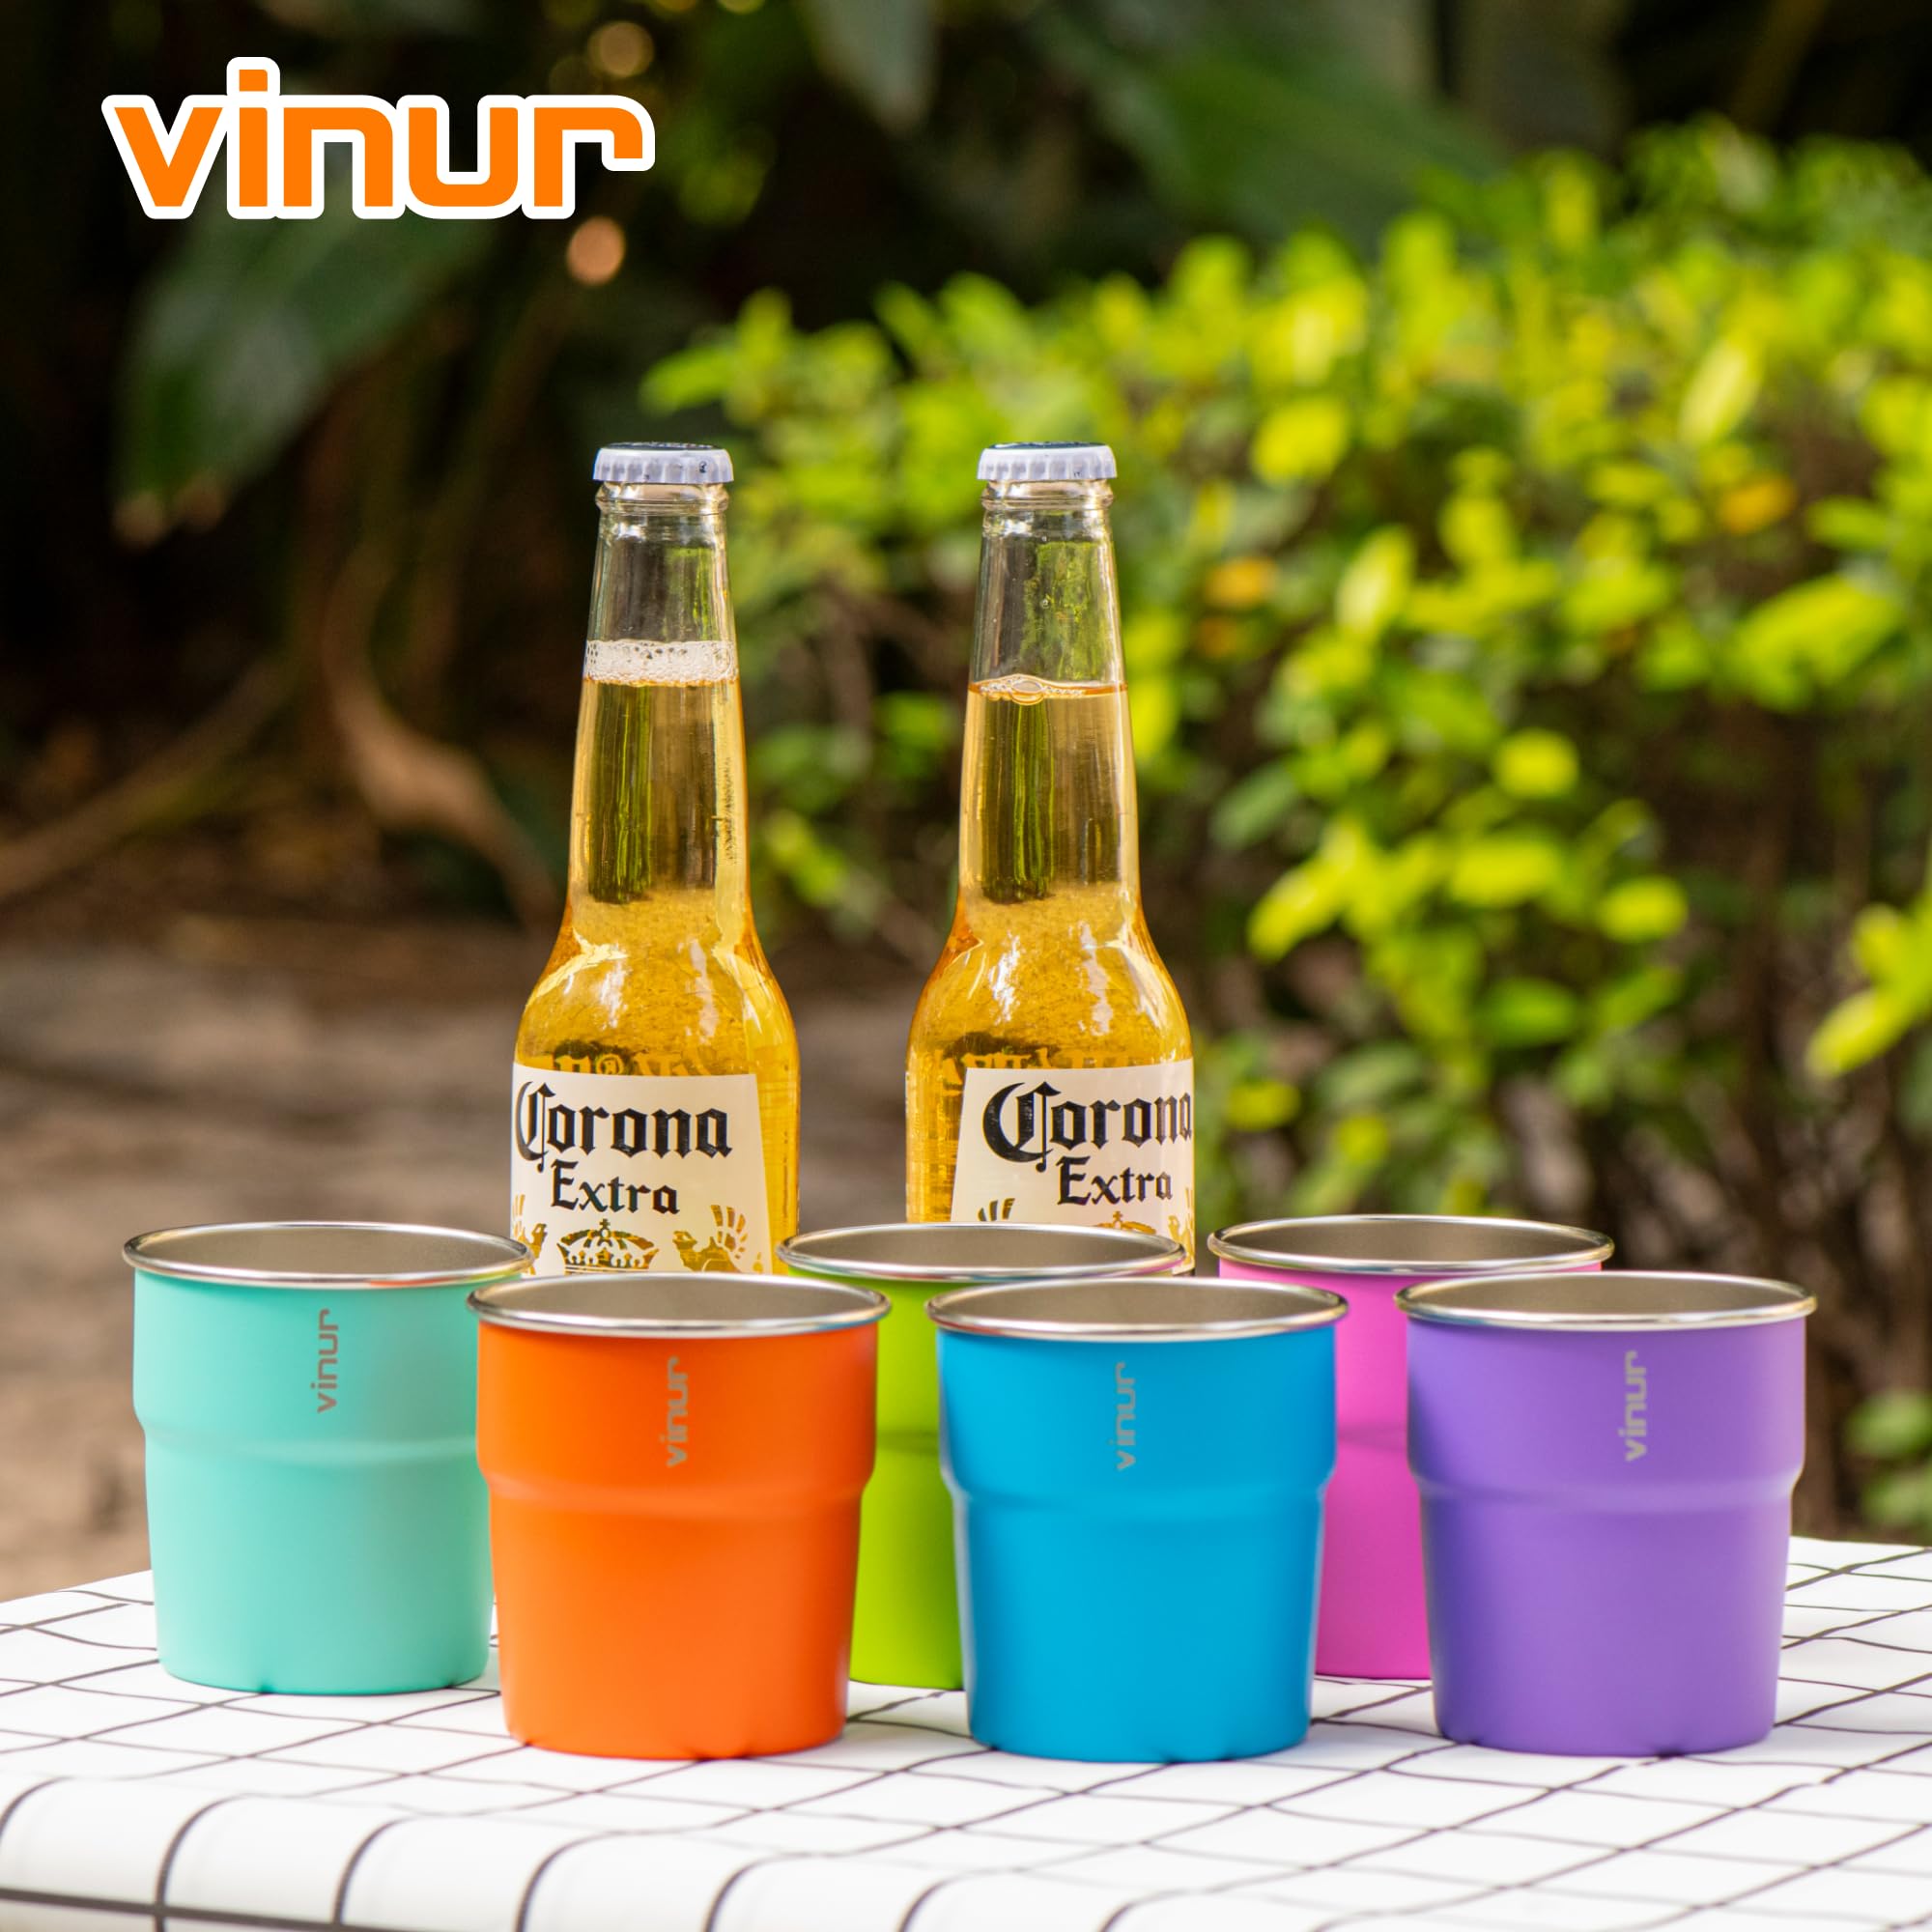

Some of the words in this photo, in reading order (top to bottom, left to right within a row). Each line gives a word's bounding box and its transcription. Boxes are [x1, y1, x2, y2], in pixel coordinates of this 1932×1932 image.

[516, 1081, 732, 1173] Corona
[982, 1081, 1192, 1172] Corona
[551, 1158, 680, 1214] Extra
[1055, 1155, 1174, 1207] Extra
[309, 1308, 339, 1414] vinur
[1616, 1350, 1648, 1462] vinur
[659, 1355, 689, 1467] vinur
[1106, 1361, 1137, 1471] vinur
